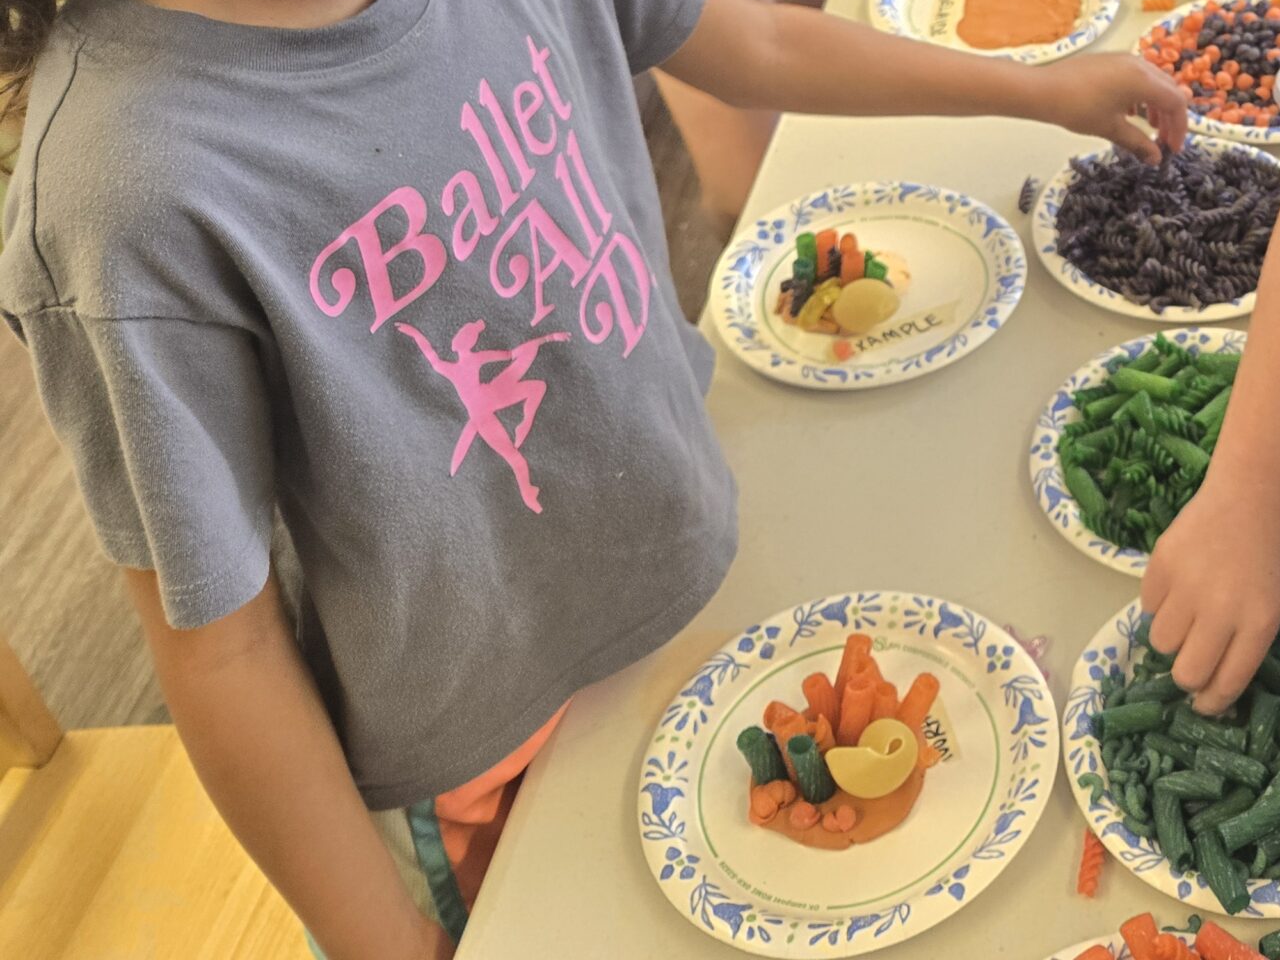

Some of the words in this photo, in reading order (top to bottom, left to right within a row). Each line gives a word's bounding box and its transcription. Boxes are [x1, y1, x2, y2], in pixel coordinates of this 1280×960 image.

[309, 34, 571, 334] Ballet
[489, 130, 613, 328] All
[854, 313, 943, 353] XAMPLE
